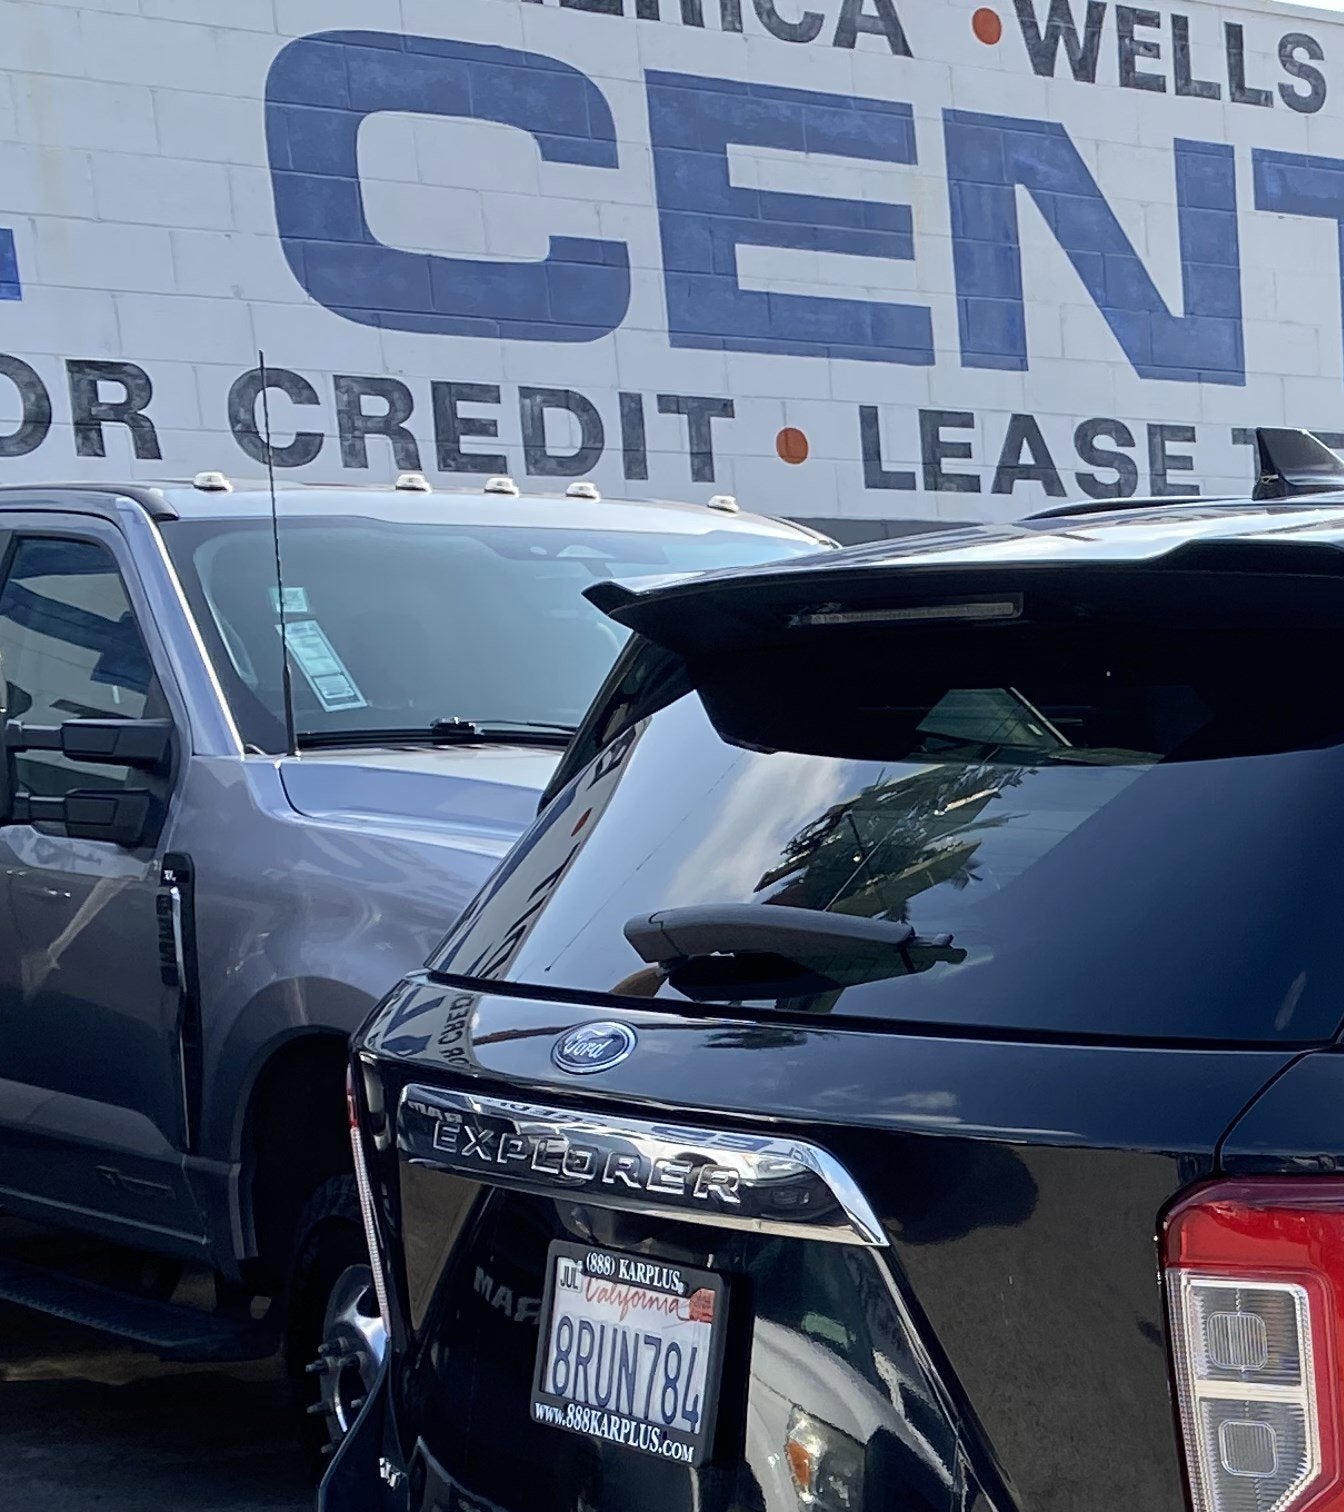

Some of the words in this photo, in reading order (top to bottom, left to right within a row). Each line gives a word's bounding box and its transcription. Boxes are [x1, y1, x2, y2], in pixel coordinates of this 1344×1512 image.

[1013, 0, 1327, 114] WELLS
[227, 367, 735, 483] CREDIT
[857, 404, 1201, 499] LEASE
[562, 1028, 613, 1058] Ford
[432, 1119, 742, 1205] EXPLORER
[559, 1262, 580, 1290] JUL
[583, 1277, 681, 1322] California
[586, 1252, 616, 1277] (888)
[618, 1258, 683, 1291] KARPLUS
[552, 1315, 700, 1434] 8RUN784
